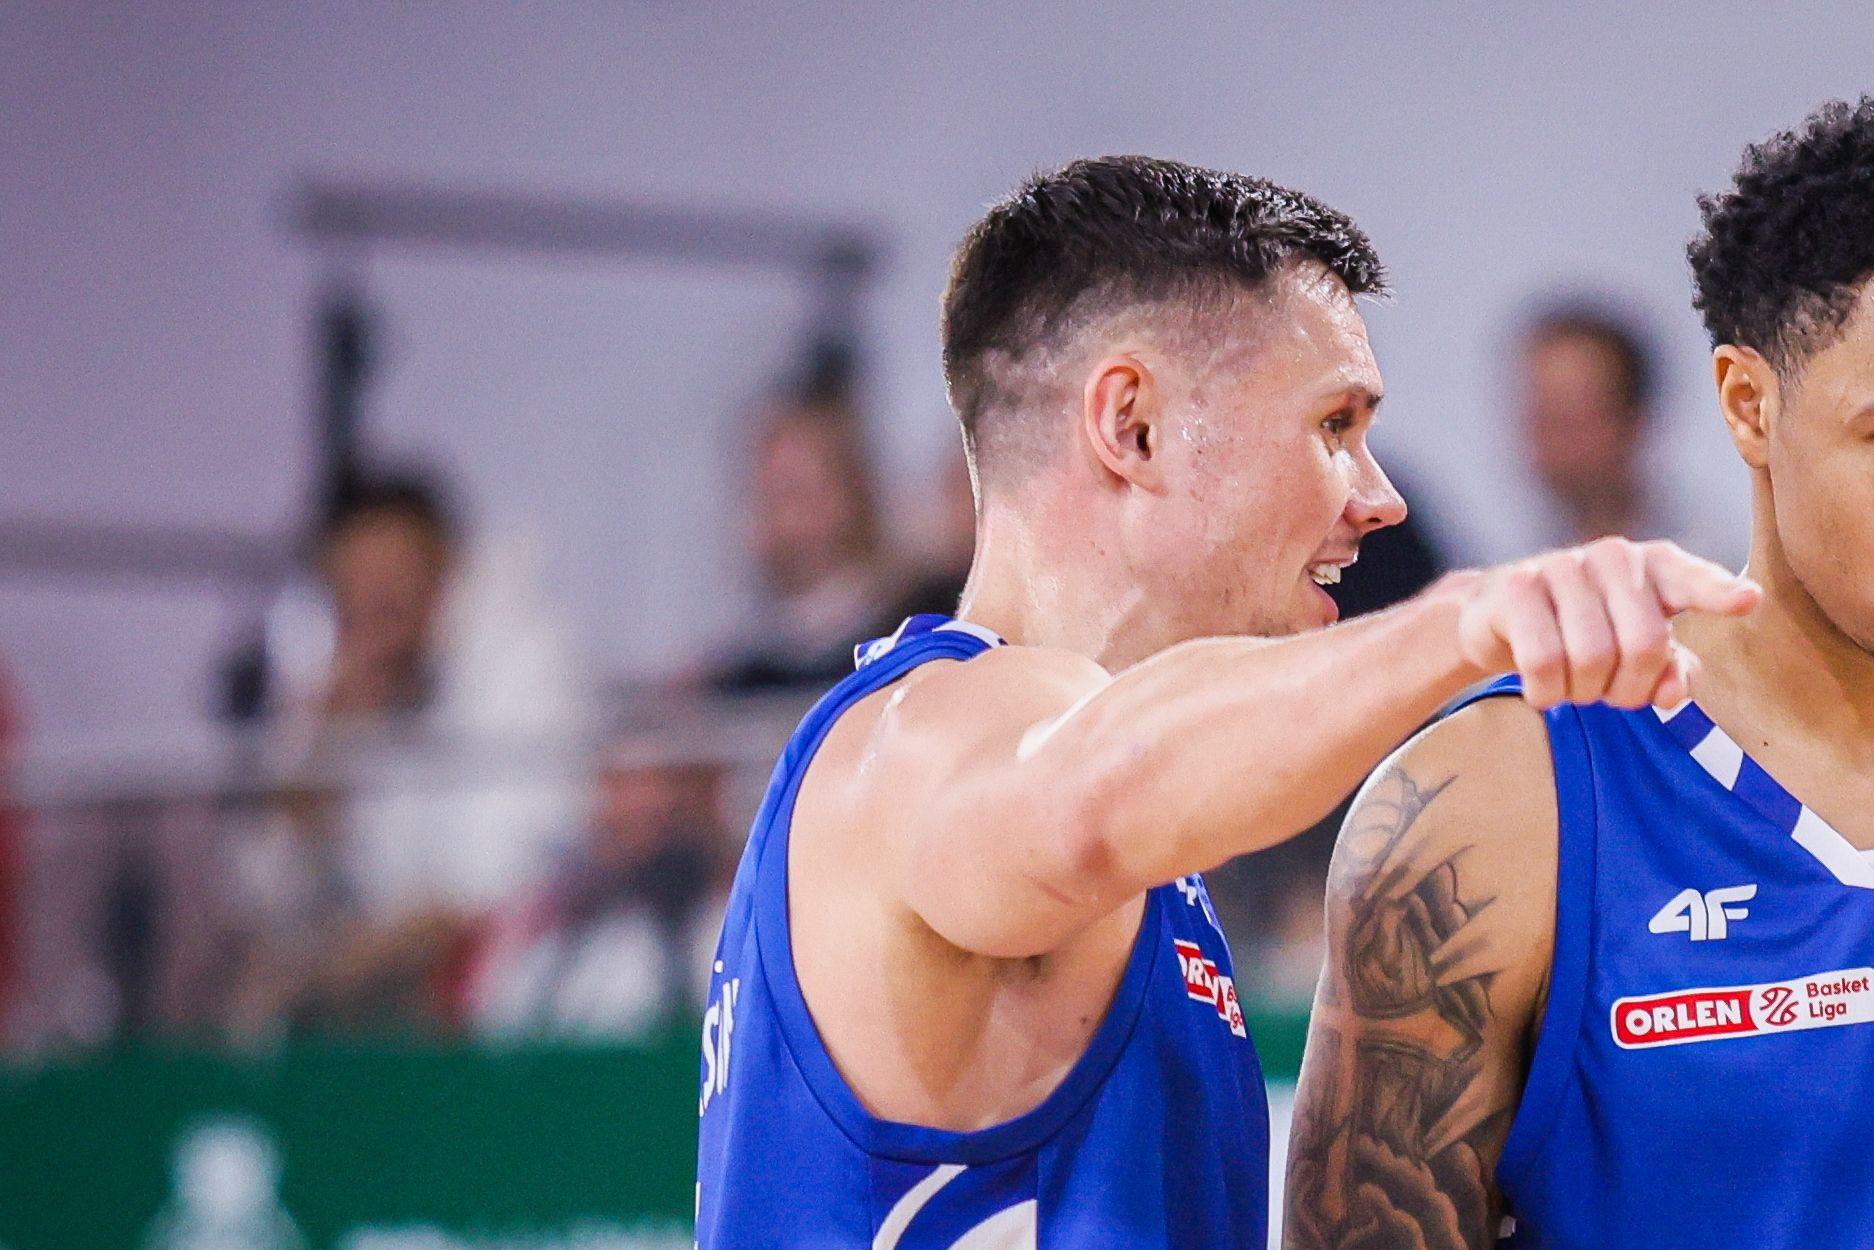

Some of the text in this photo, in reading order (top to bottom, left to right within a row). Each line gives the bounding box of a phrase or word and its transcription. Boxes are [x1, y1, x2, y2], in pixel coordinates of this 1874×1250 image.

[1648, 884, 1758, 941] 4F
[1806, 976, 1869, 998] Basket
[1625, 999, 1742, 1036] ORLEN
[1809, 1001, 1848, 1020] Liga
